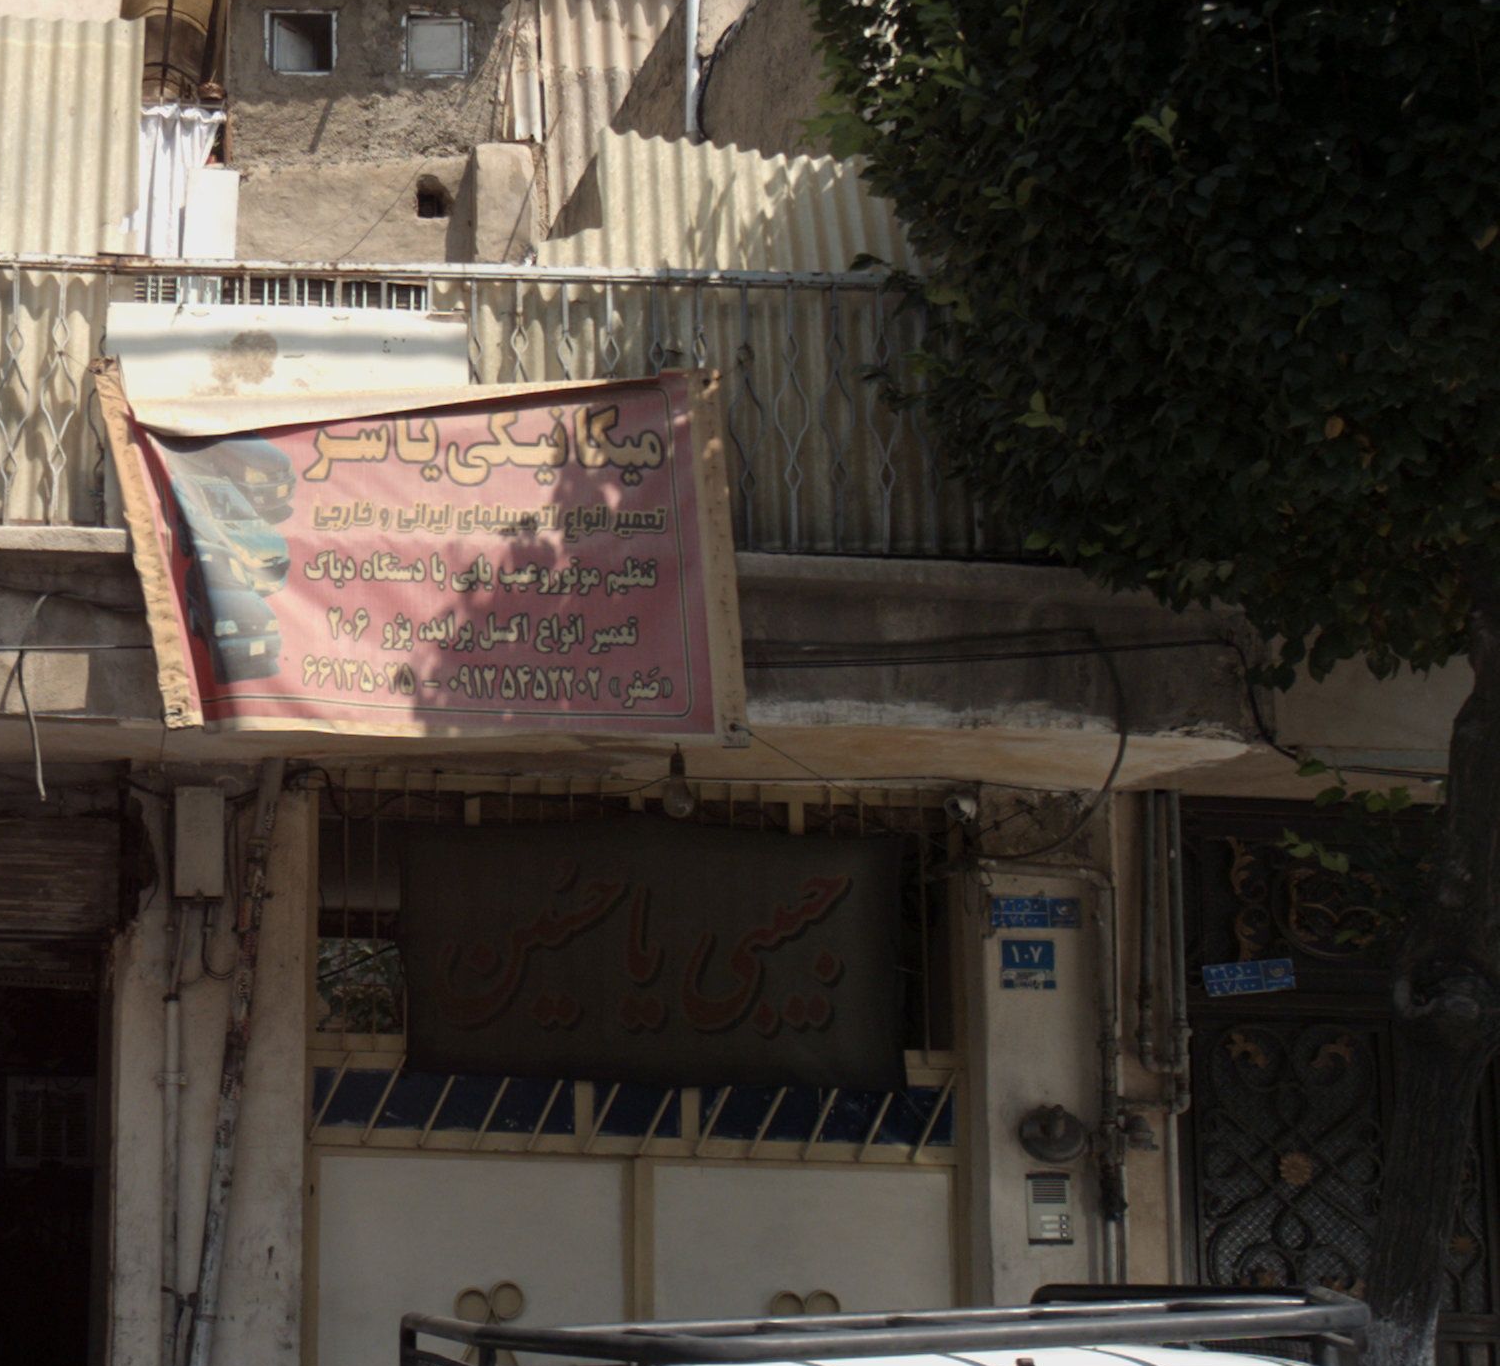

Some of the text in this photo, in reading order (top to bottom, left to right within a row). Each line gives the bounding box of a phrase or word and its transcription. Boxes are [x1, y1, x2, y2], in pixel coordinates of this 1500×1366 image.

[302, 419, 442, 482] یاسر
[313, 500, 374, 532] خارجی
[378, 506, 393, 531] و
[396, 500, 451, 533] ایرانی
[563, 503, 609, 541] انواع
[613, 507, 668, 534] تعمیر
[304, 549, 357, 589] دیاگ
[360, 550, 427, 582] دستگاه
[430, 551, 447, 591] با
[451, 553, 494, 593] یابی
[606, 556, 658, 597] تنظیم
[327, 606, 370, 642] ۲۰۶
[381, 612, 414, 652] پژو
[478, 611, 530, 651] اکسل
[534, 612, 585, 654] انواع
[588, 616, 639, 654] تعمیر
[620, 882, 669, 1033] یا
[1011, 944, 1043, 964] ۱۰۷
